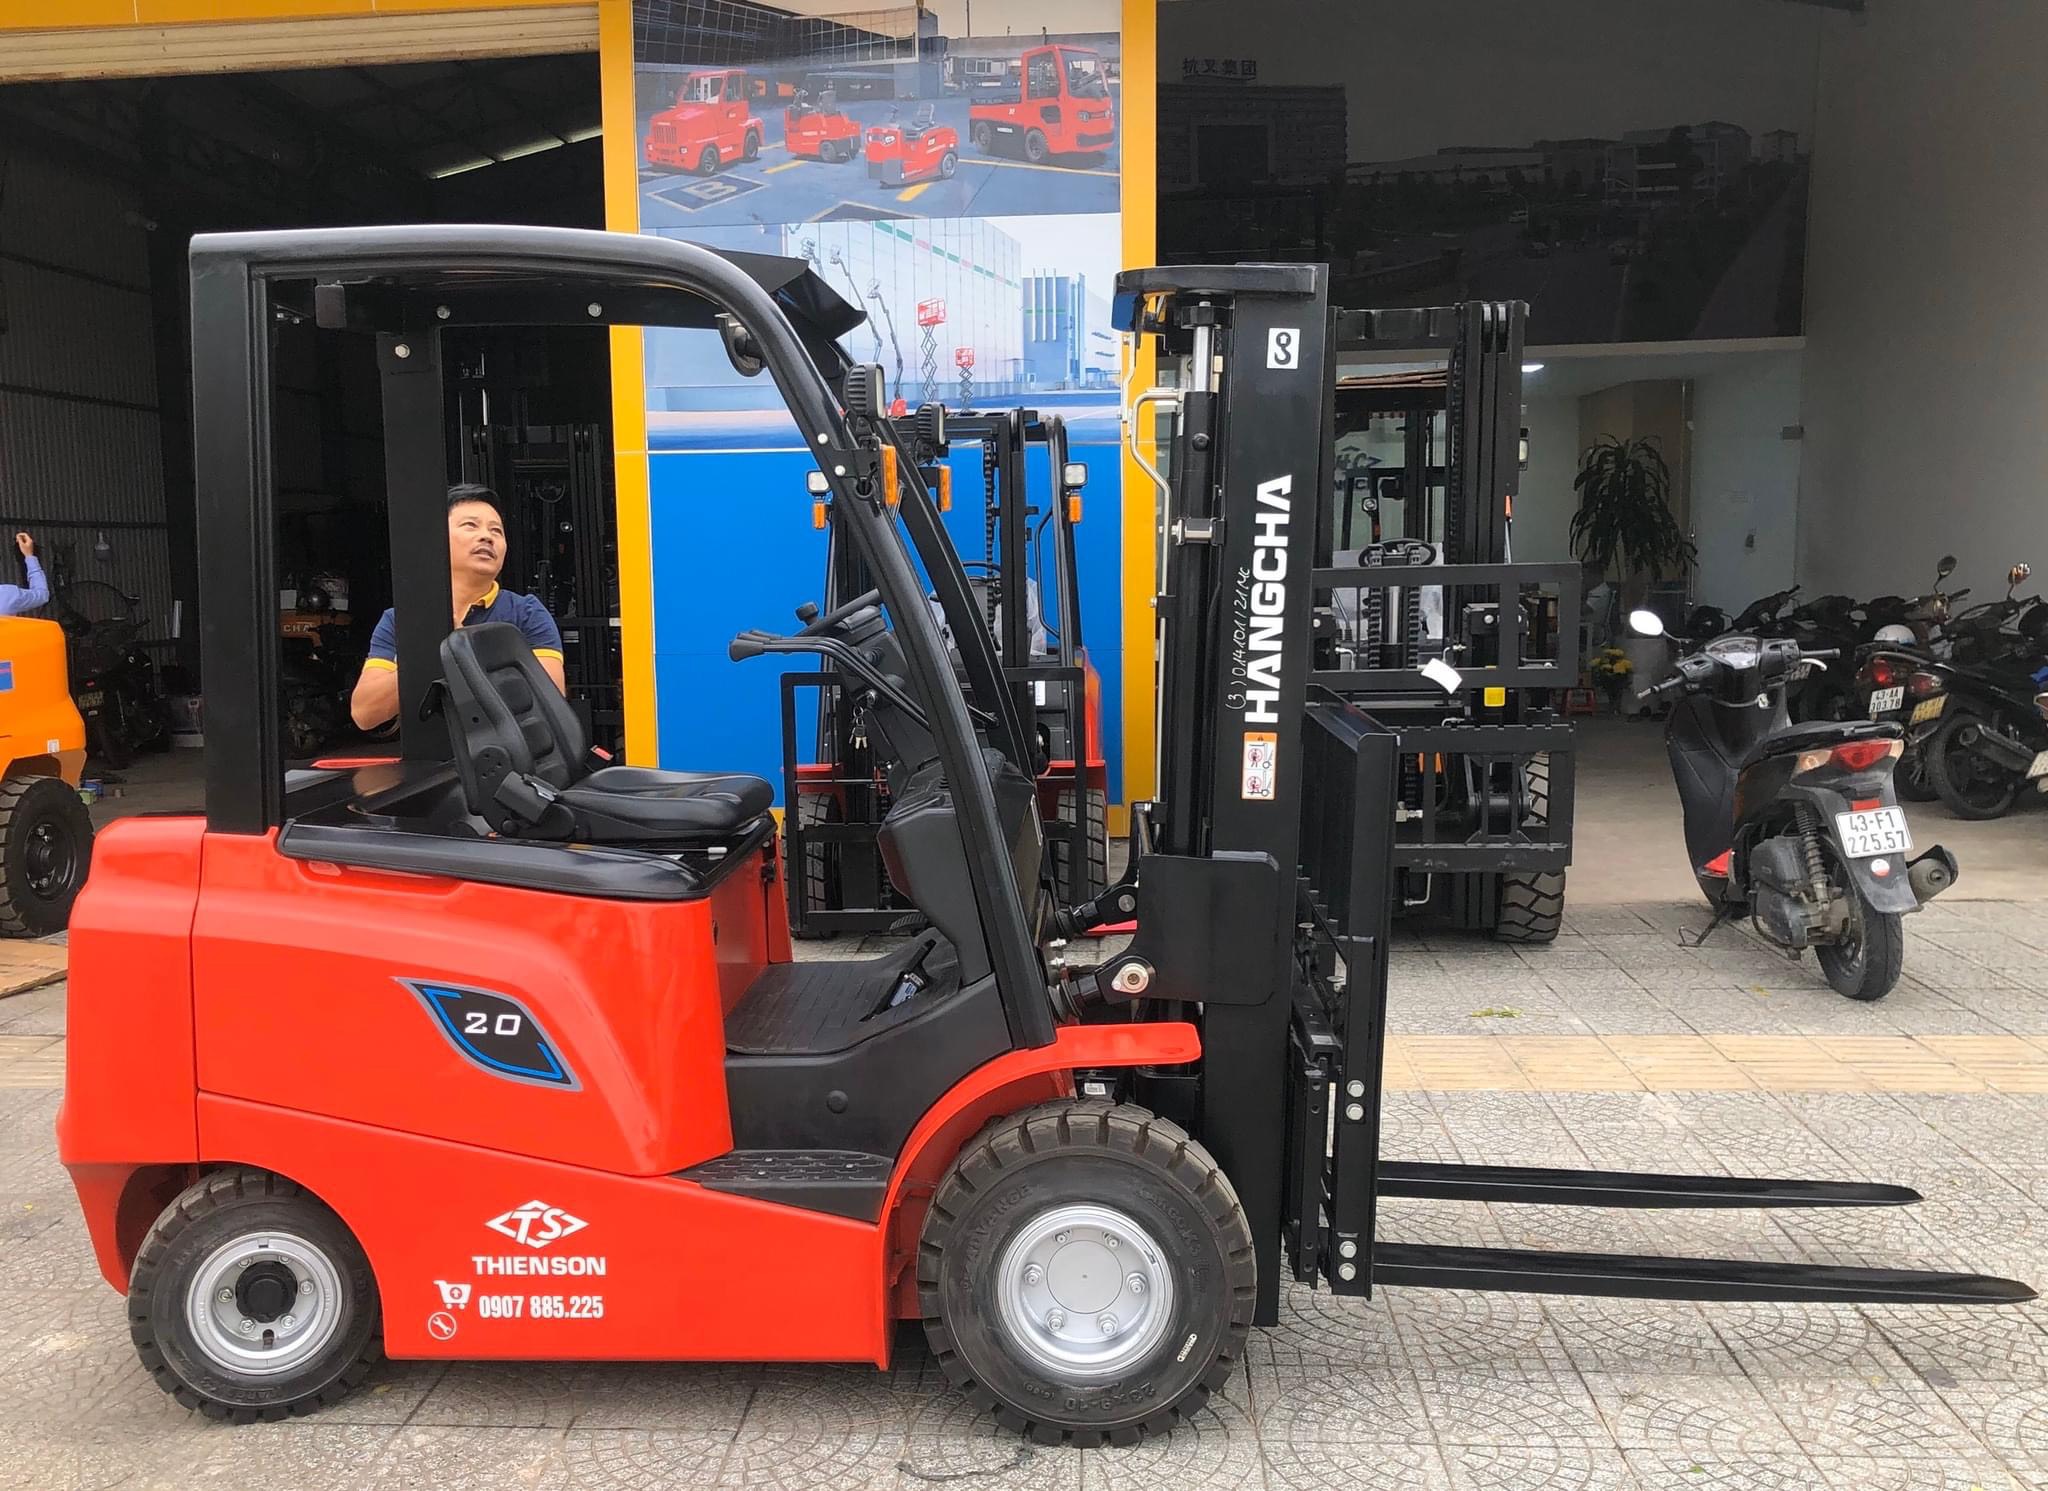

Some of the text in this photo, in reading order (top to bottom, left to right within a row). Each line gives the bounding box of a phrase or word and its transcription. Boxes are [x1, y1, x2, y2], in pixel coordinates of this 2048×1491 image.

[1244, 474, 1292, 723] HANGCHA
[1849, 811, 1896, 833] 43-F1
[1848, 830, 1907, 855] 225.57
[464, 1012, 521, 1036] 20
[510, 1207, 566, 1245] TS
[479, 1295, 604, 1318] 0907 885.225
